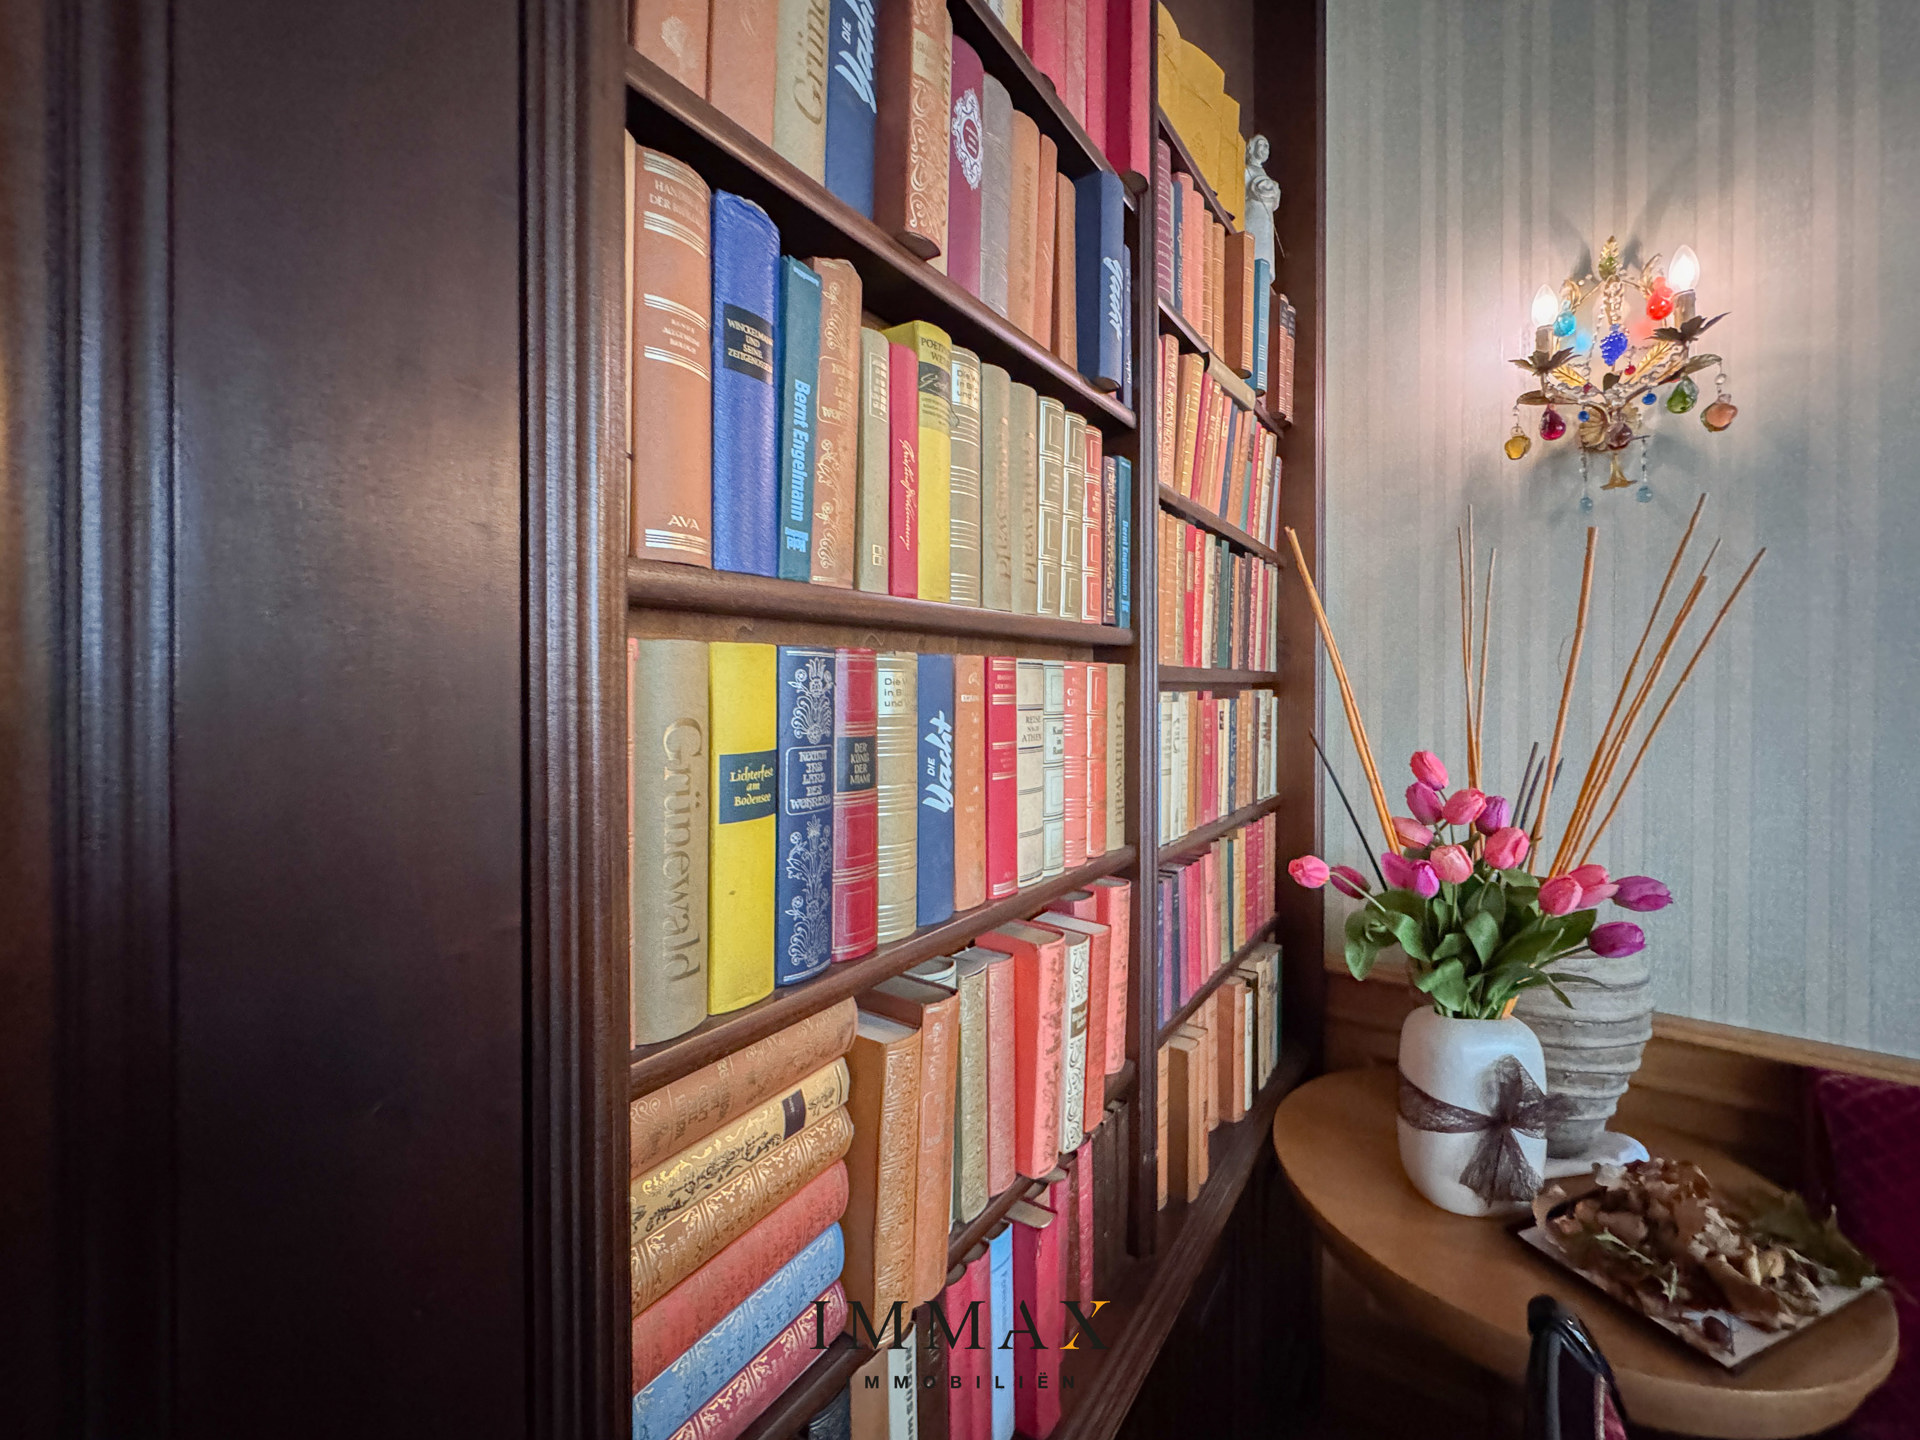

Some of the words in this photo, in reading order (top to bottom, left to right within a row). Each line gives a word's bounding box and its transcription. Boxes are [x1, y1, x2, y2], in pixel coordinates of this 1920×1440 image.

[841, 17, 852, 45] DIE
[793, 0, 825, 125] Grün
[834, 0, 877, 114] Yach
[793, 379, 811, 429] Bernt
[791, 427, 809, 522] Engelmann
[667, 514, 700, 531] AVA
[729, 764, 774, 782] Lichterfest
[922, 710, 954, 813] Yacht
[927, 757, 936, 777] DIE
[734, 793, 771, 807] Bodensee
[746, 781, 760, 791] am
[661, 716, 703, 982] Grünewald
